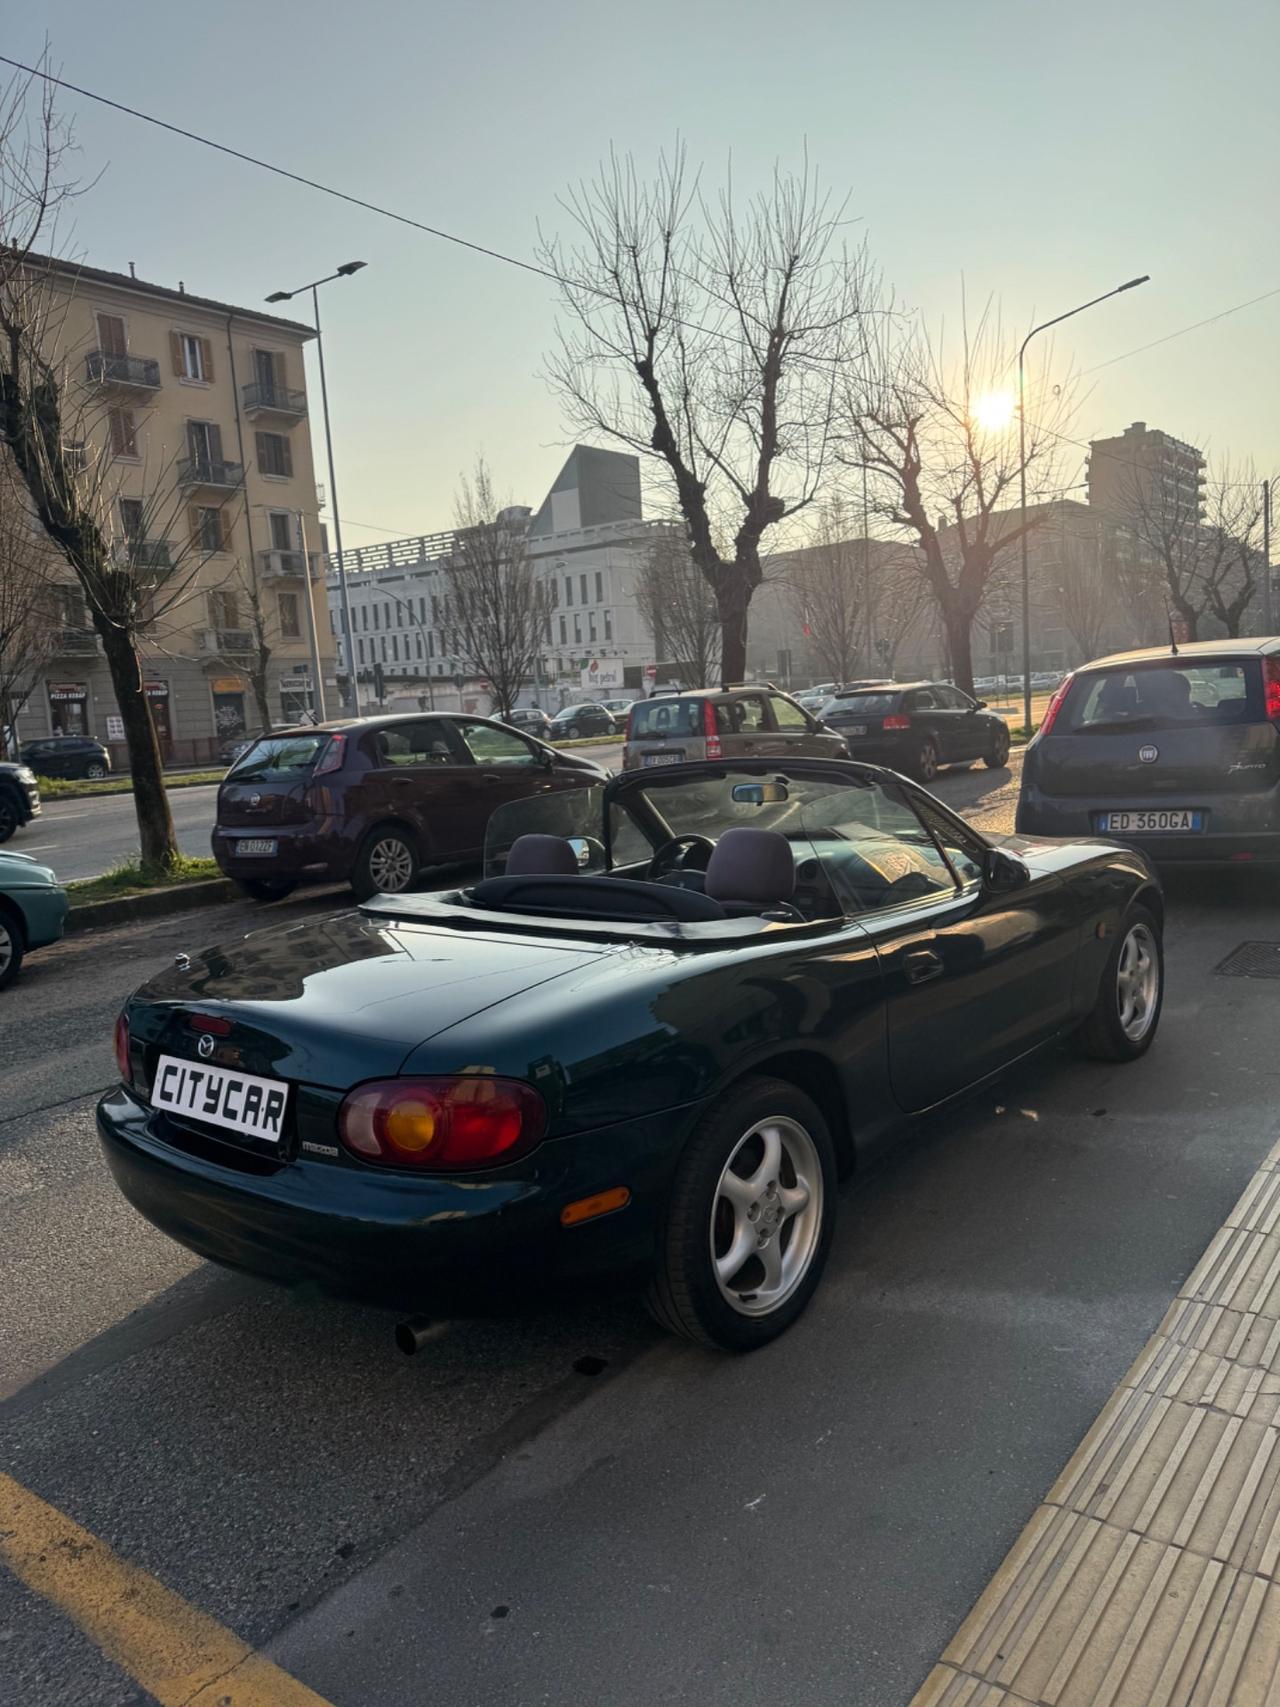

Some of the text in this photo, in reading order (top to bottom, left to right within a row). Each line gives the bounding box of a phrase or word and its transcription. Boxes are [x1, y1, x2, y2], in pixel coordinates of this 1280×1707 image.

[50, 692, 67, 700] PIZZA
[1109, 812, 1191, 830] ED 360GA
[159, 1064, 285, 1134] CITYCAR
